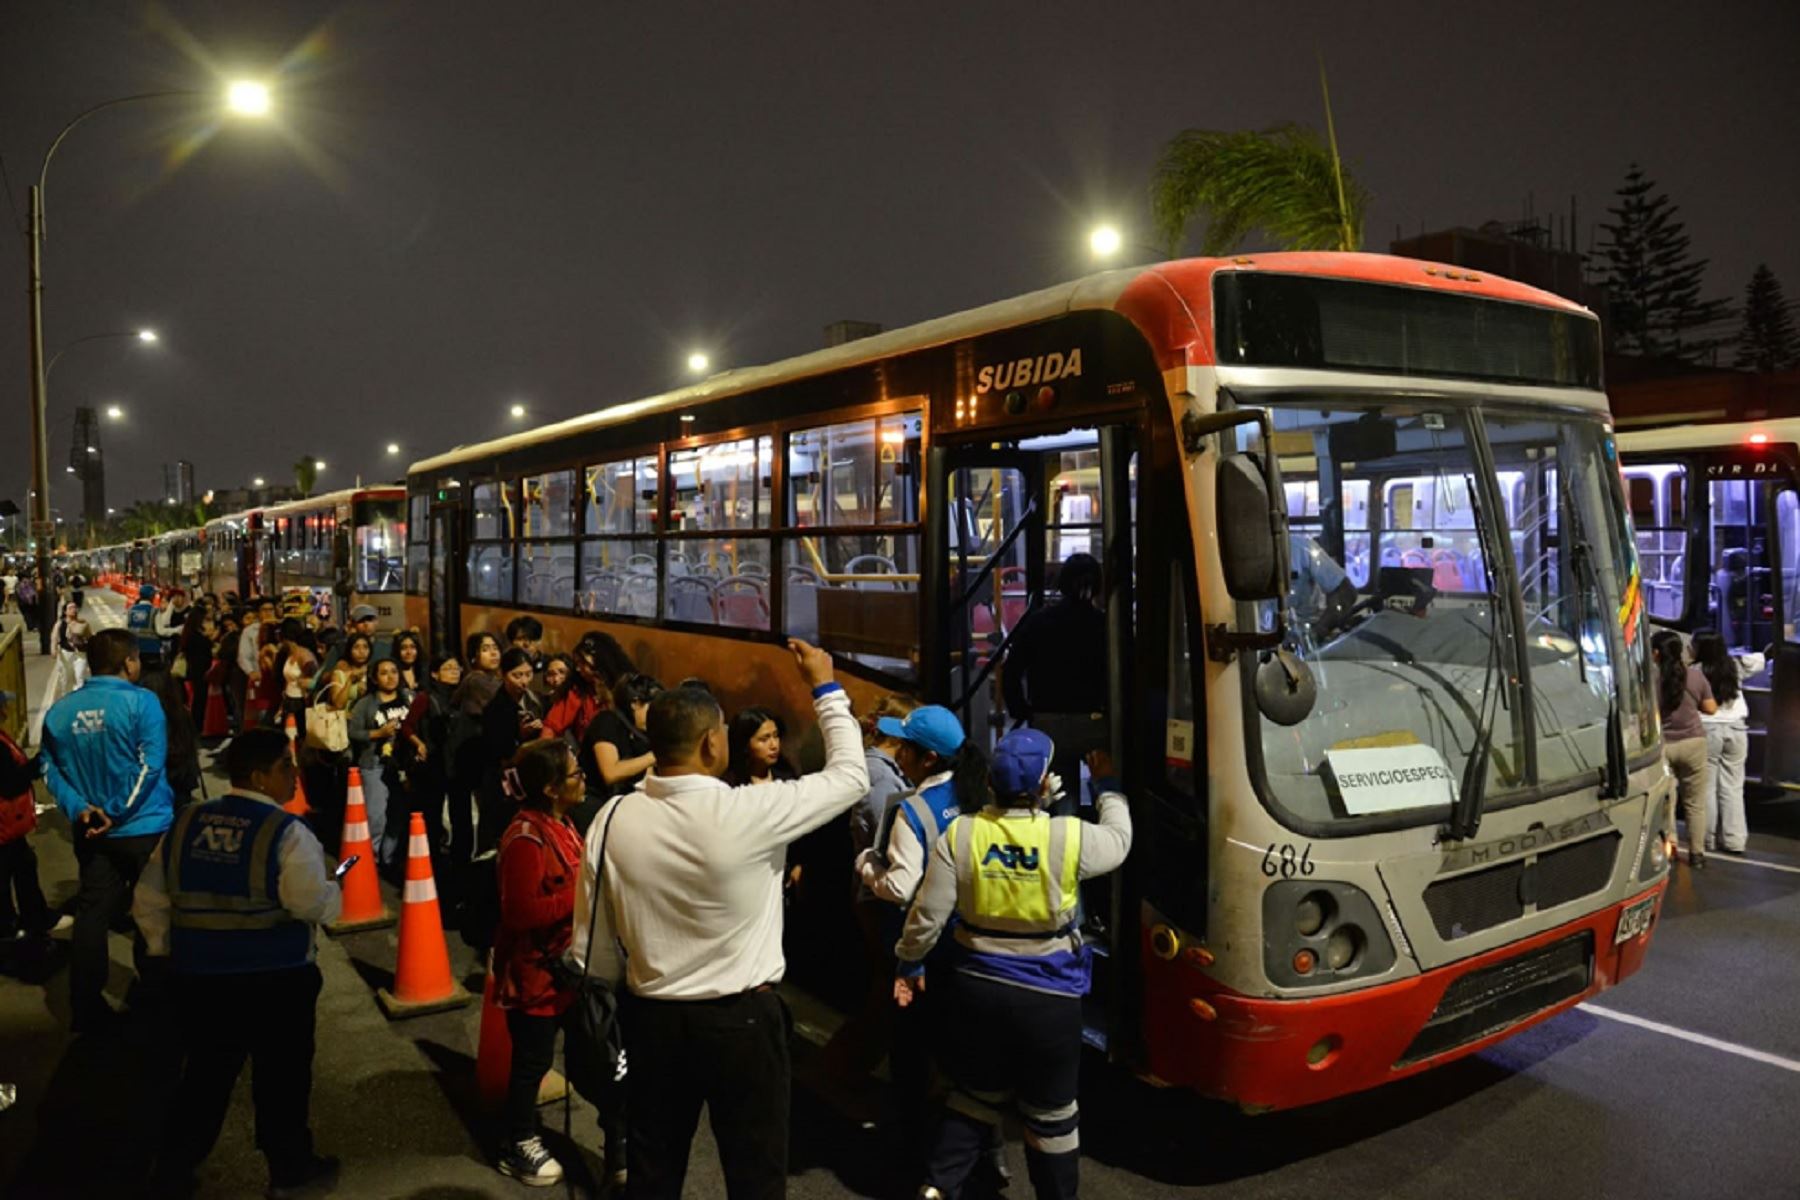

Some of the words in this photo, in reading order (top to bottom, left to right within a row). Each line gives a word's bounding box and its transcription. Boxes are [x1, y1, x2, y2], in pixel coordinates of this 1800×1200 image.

[976, 347, 1082, 394] SUBIDA
[1339, 765, 1453, 788] SERVICIOESPEC
[981, 843, 1039, 871] ATU
[1261, 842, 1315, 879] 686
